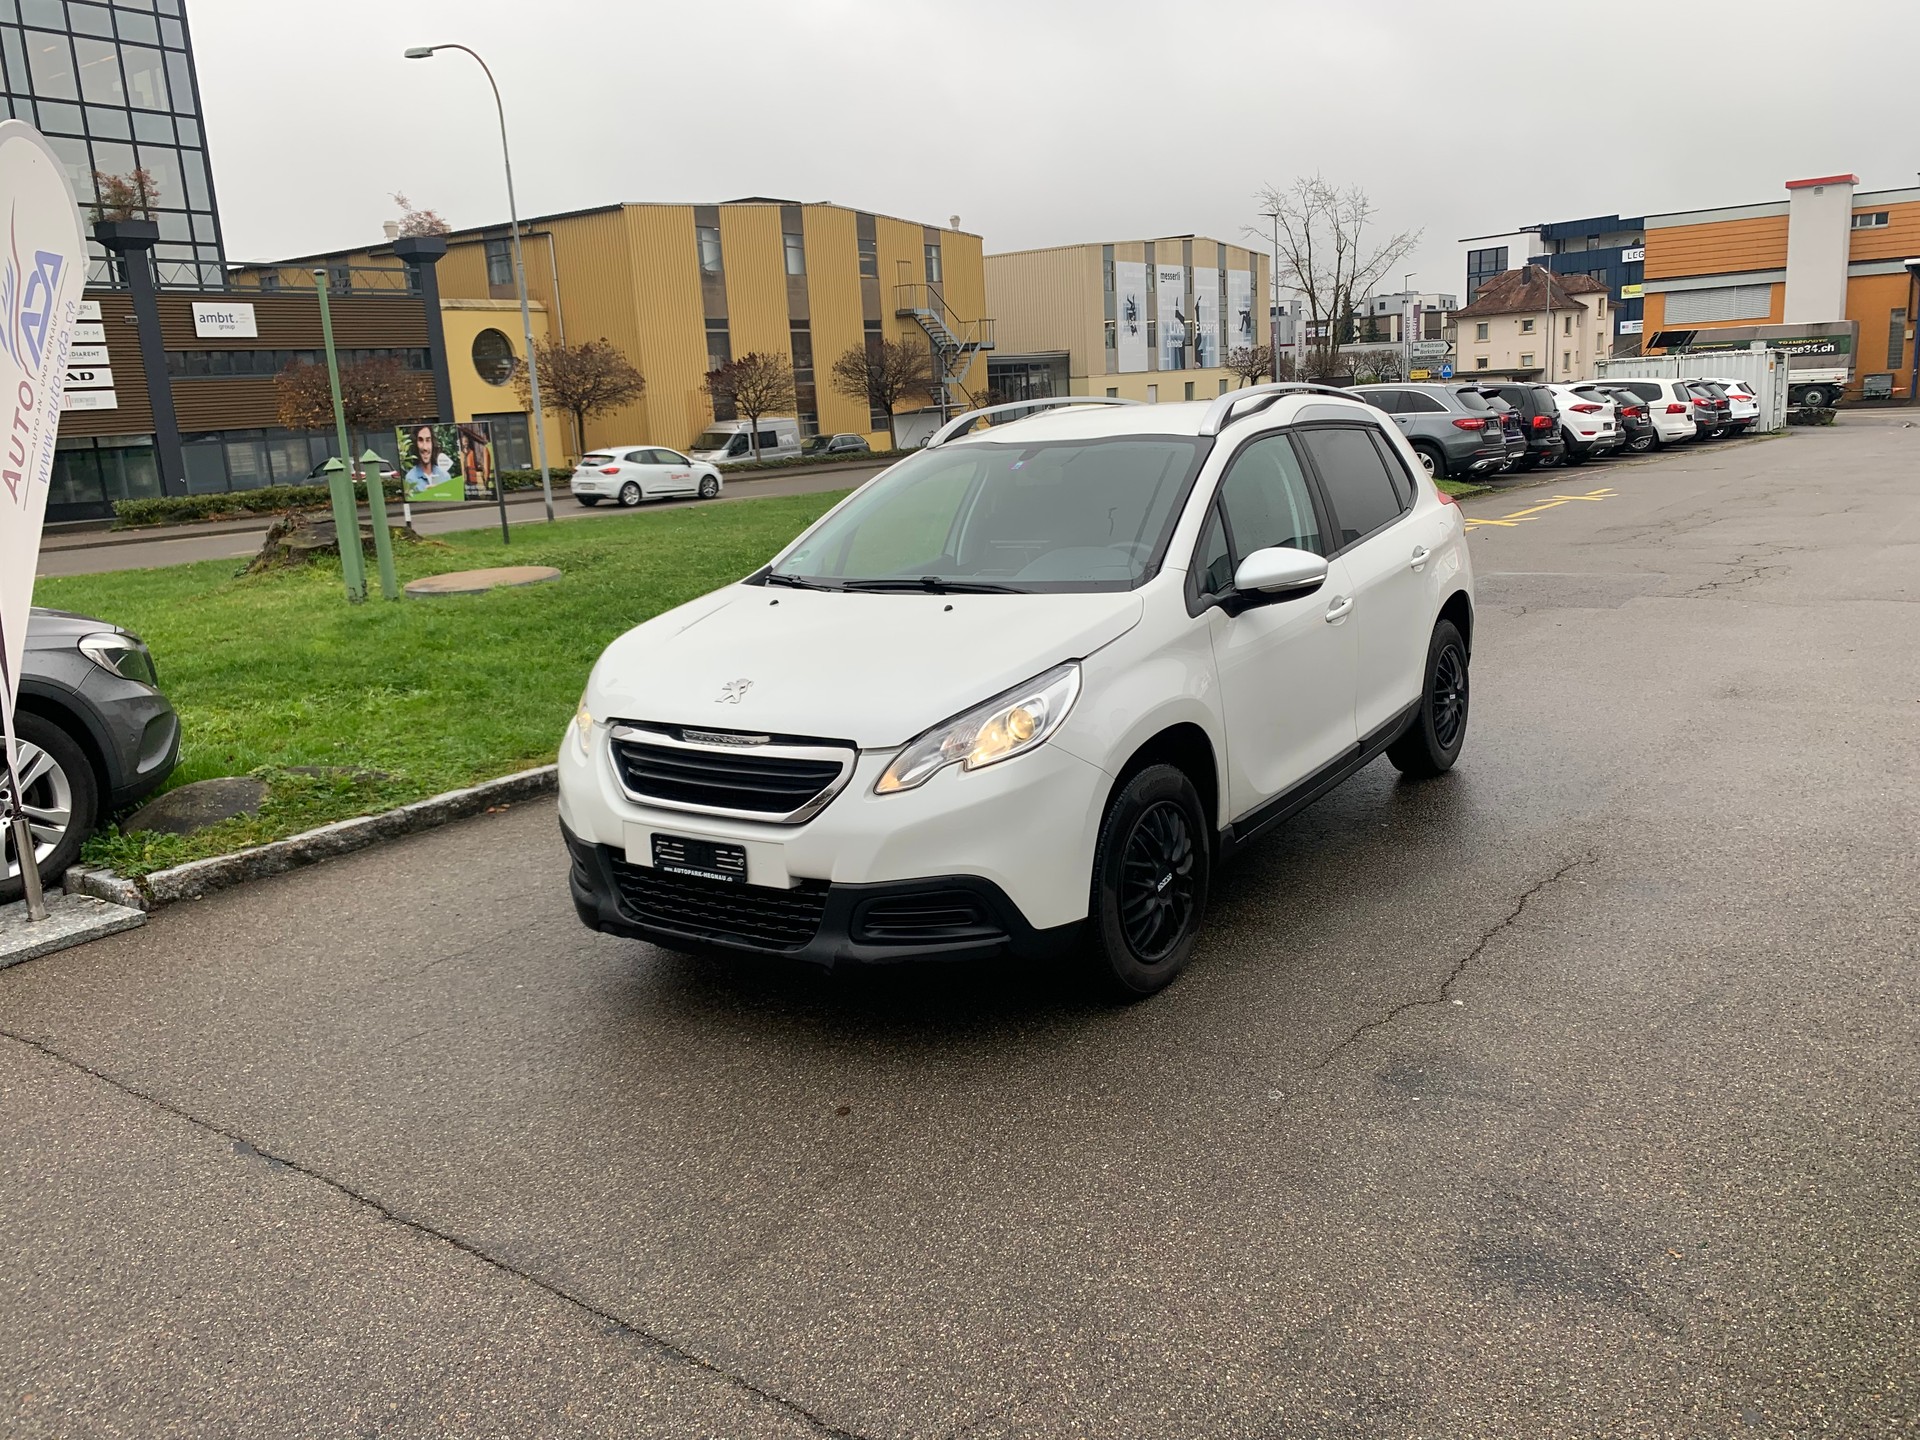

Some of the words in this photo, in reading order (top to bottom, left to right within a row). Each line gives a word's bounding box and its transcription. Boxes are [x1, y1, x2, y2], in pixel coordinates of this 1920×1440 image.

[1160, 271, 1181, 280] messerli
[2, 381, 34, 505] AUTO
[21, 250, 63, 371] ADA
[32, 418, 40, 448] AUTO
[37, 398, 43, 414] AN
[45, 313, 58, 360] VERKAUF
[38, 301, 76, 484] www.auto-ada.ch
